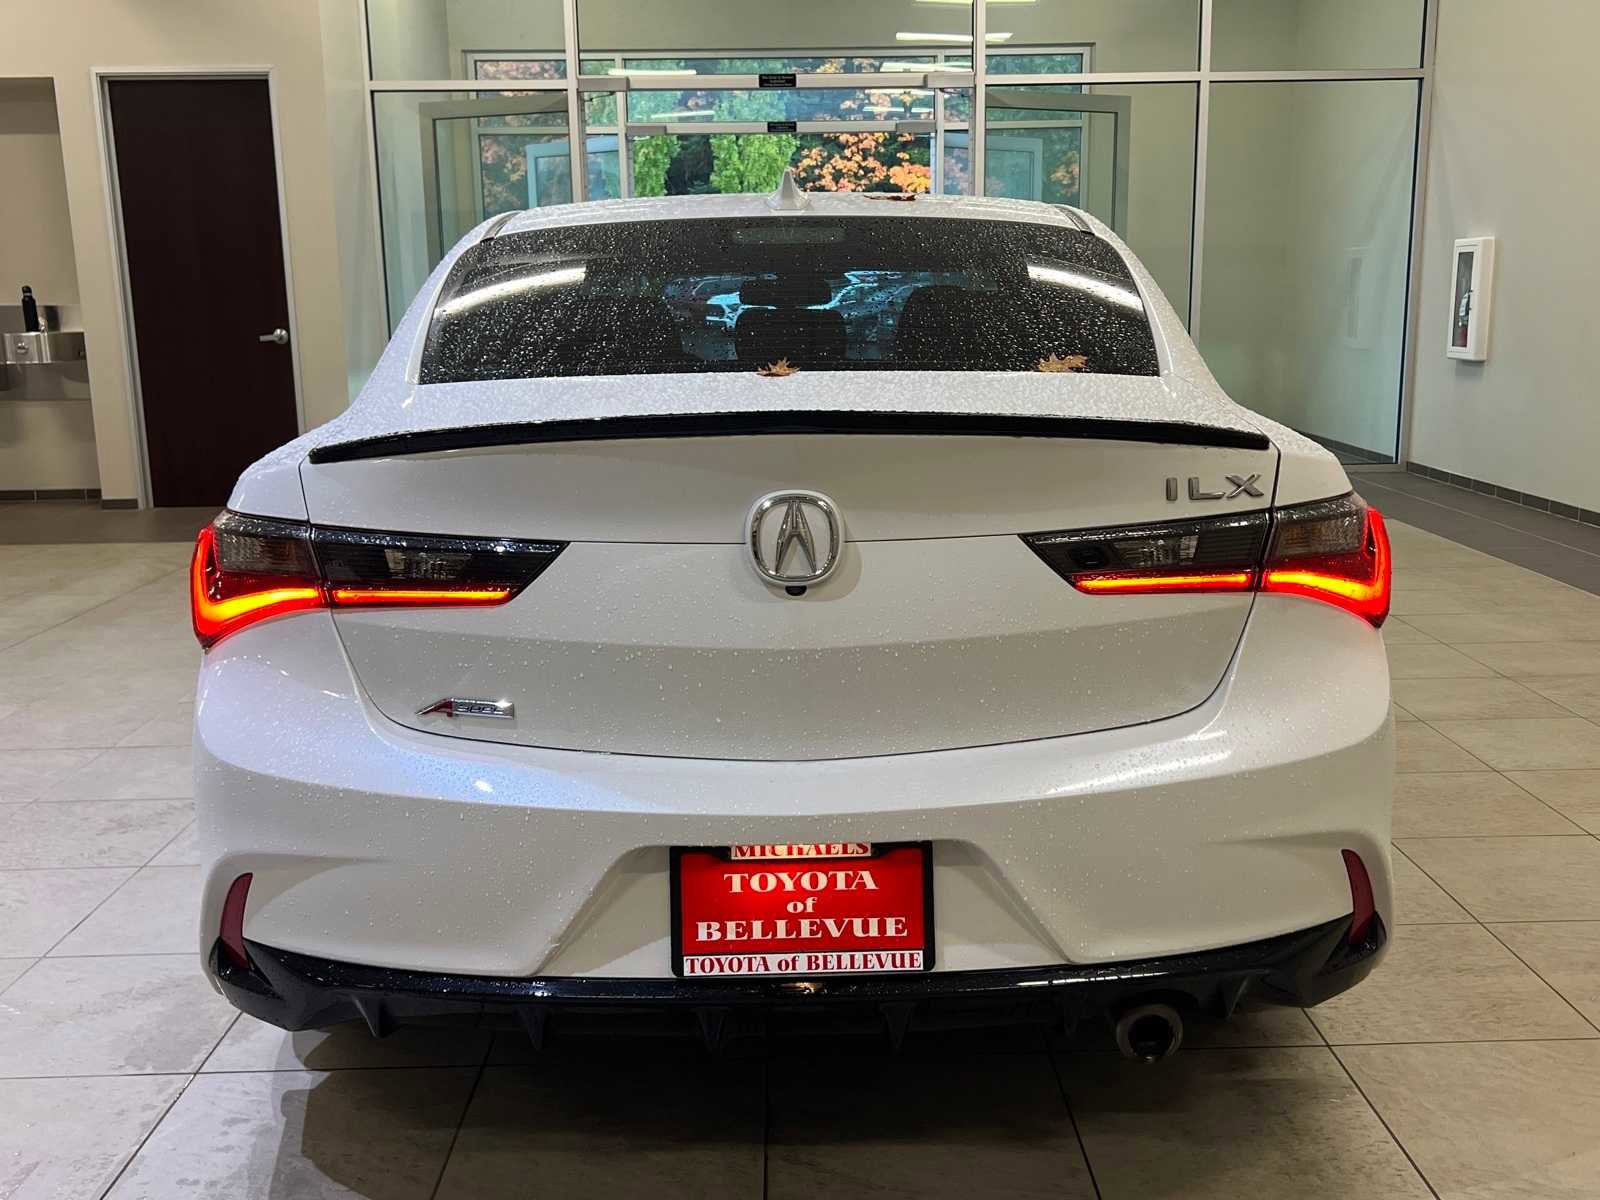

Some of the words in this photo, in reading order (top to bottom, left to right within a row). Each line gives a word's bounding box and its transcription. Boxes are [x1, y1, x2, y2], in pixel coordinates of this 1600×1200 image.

[1165, 474, 1265, 501] ILX
[733, 842, 871, 858] MICHAELS
[723, 870, 879, 893] TOYOTA
[786, 897, 818, 914] of
[695, 917, 908, 942] BELLEVUE
[685, 956, 771, 974] TOYOTA
[777, 954, 799, 971] of
[806, 951, 922, 971] BELLEVUE
